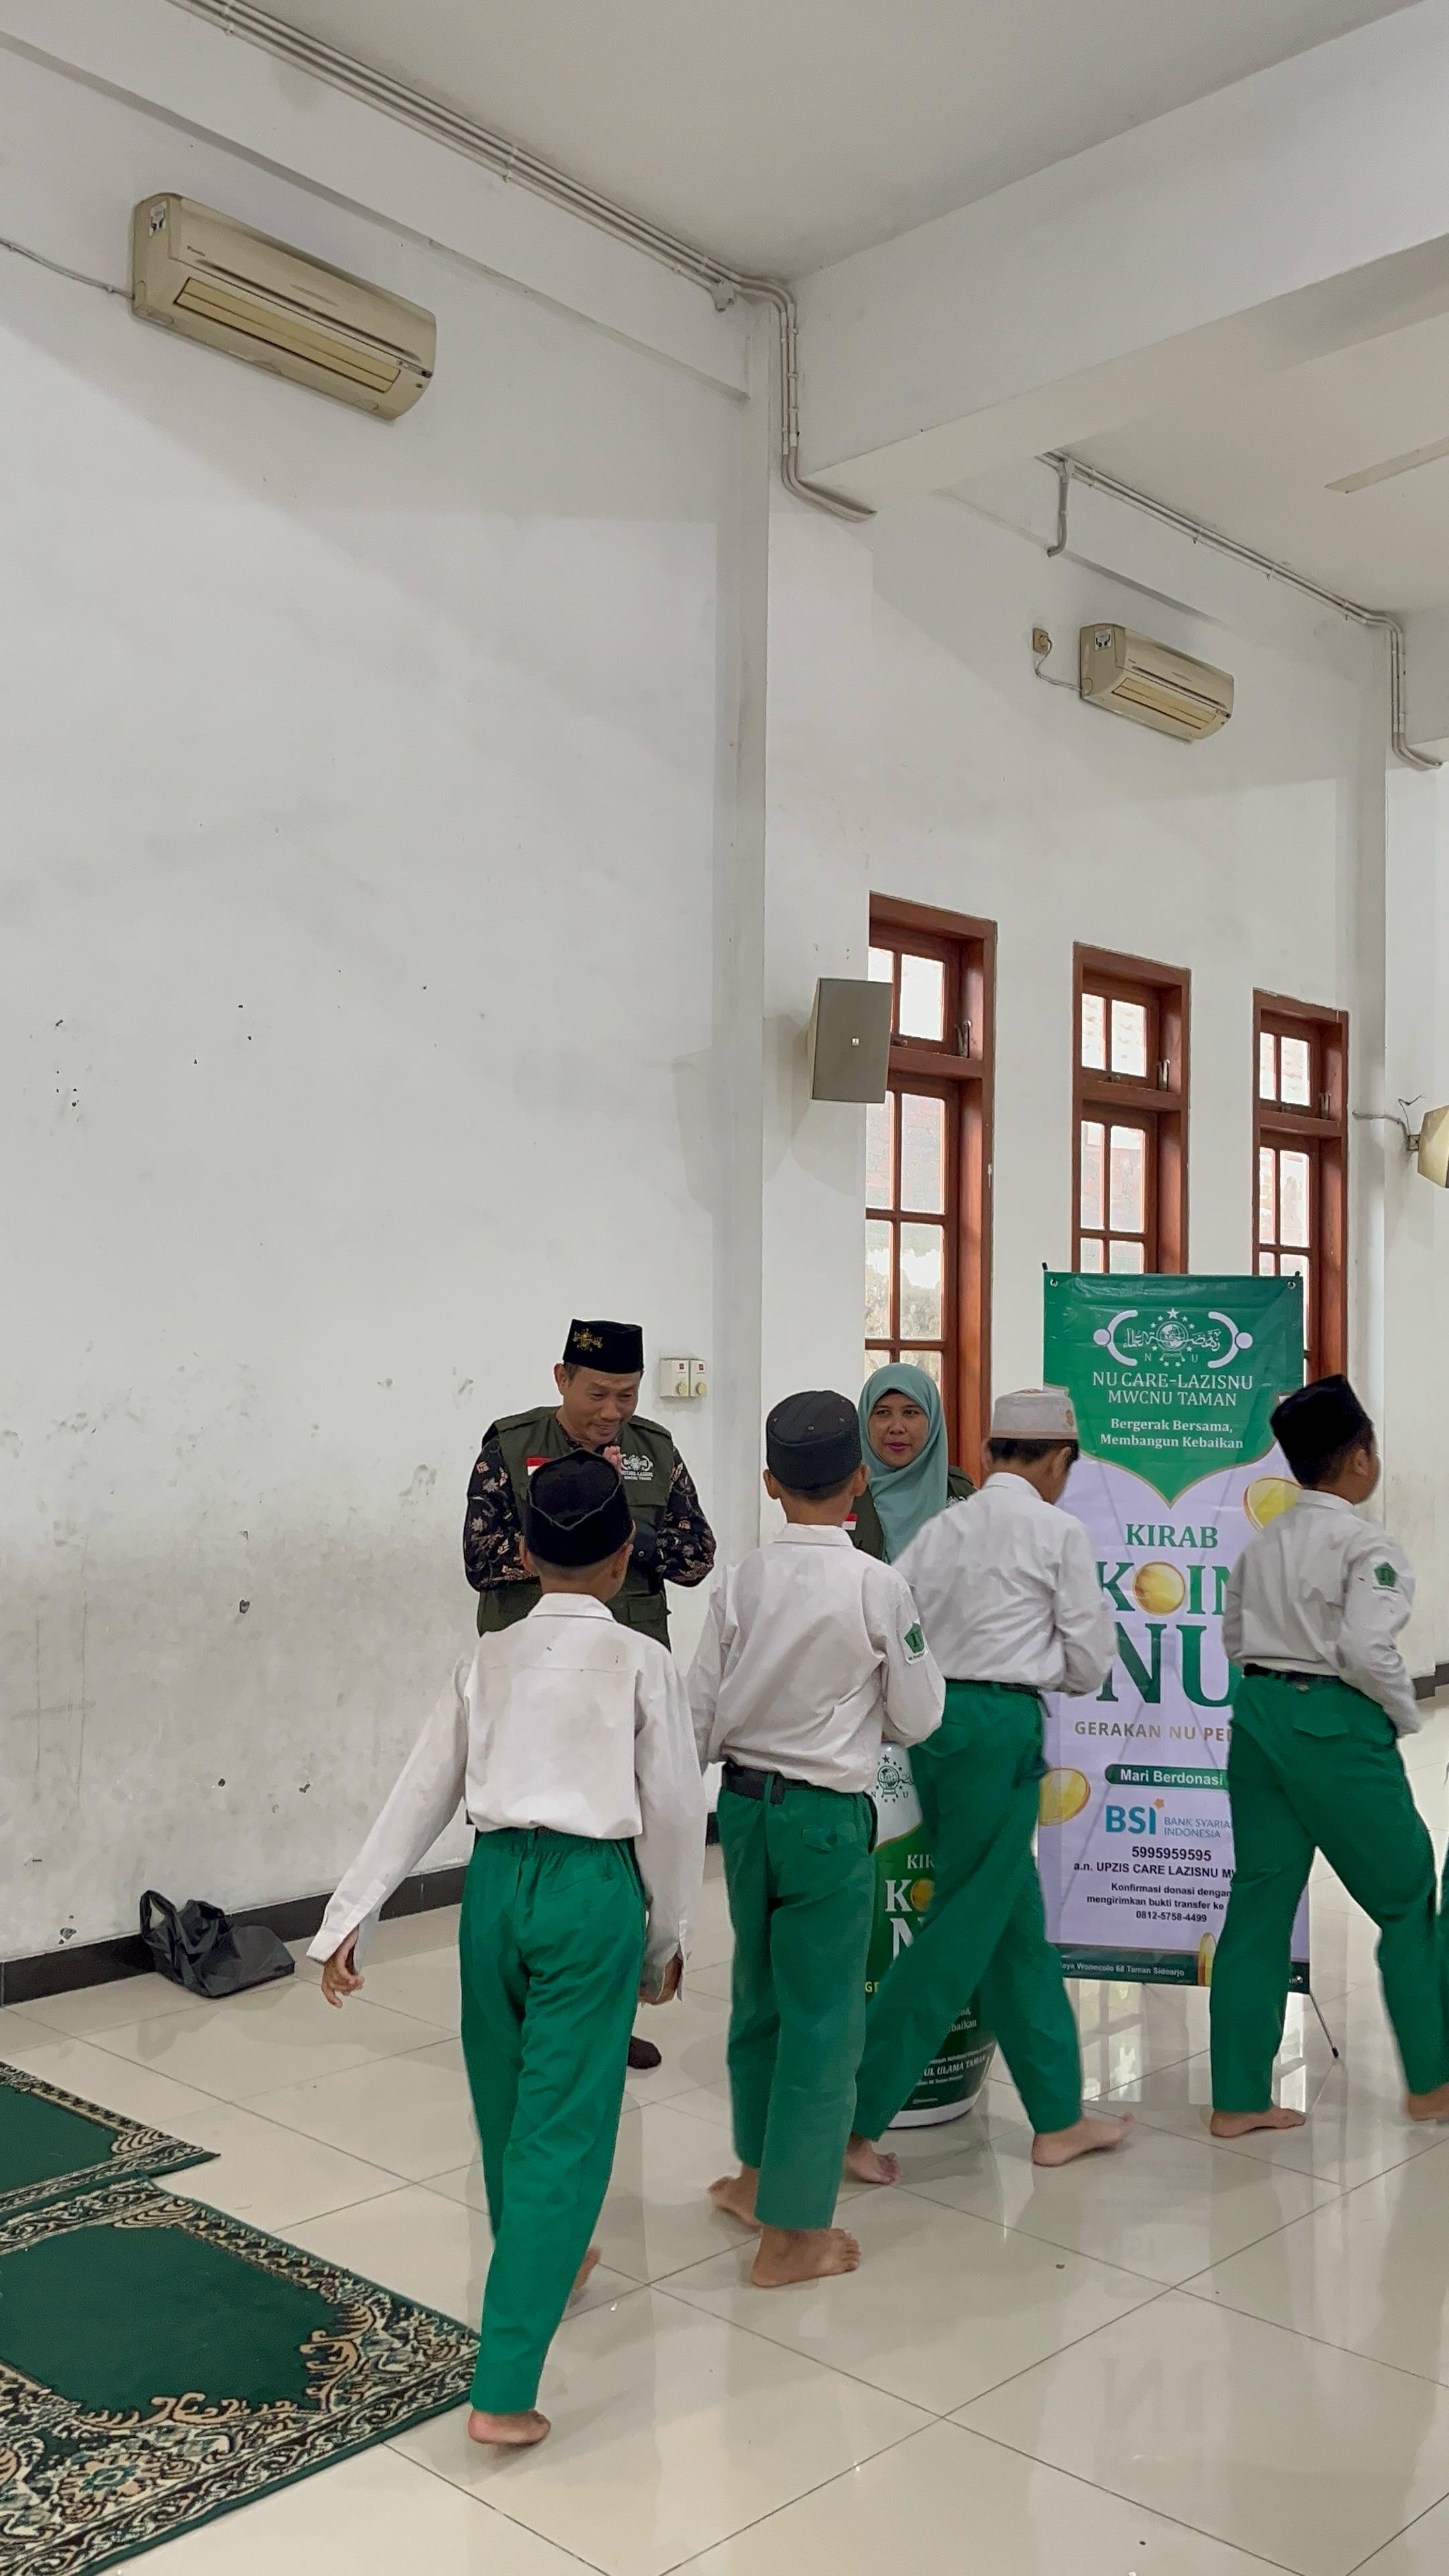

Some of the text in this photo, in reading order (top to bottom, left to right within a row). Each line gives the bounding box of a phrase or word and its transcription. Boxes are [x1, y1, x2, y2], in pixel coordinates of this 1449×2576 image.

[1144, 1353, 1198, 1362] N U
[1092, 1371, 1253, 1390] NU CARE-LAZISNU
[1108, 1390, 1236, 1407] MWCNU TAMAN
[1110, 1418, 1233, 1434] Bergerak Bersama,
[1100, 1434, 1244, 1448] Membangun Kebaikan
[1126, 1523, 1219, 1548] KIRAB
[1096, 1621, 1238, 1707] NU
[1075, 1721, 1161, 1739] GERAKAN
[1169, 1726, 1196, 1739] NU
[1120, 1769, 1223, 1786] Mari Berdonasi
[1106, 1805, 1156, 1835] BSI
[1164, 1817, 1192, 1827] BANK
[1164, 1827, 1221, 1838] INDONESIA
[1132, 1846, 1212, 1862] 5995959595
[1074, 1862, 1093, 1872] a.n.
[1096, 1862, 1129, 1873] UPZIS
[1133, 1864, 1165, 1875] CARE
[1169, 1866, 1218, 1878] LAZISNU
[1111, 1882, 1161, 1893] Konfirmasi
[1164, 1885, 1195, 1895] donasi
[1087, 1894, 1224, 1911] mengirimkan bukti transfer ke
[1136, 1911, 1207, 1923] 0812-5758-4499
[1127, 1966, 1151, 1974] Taman
